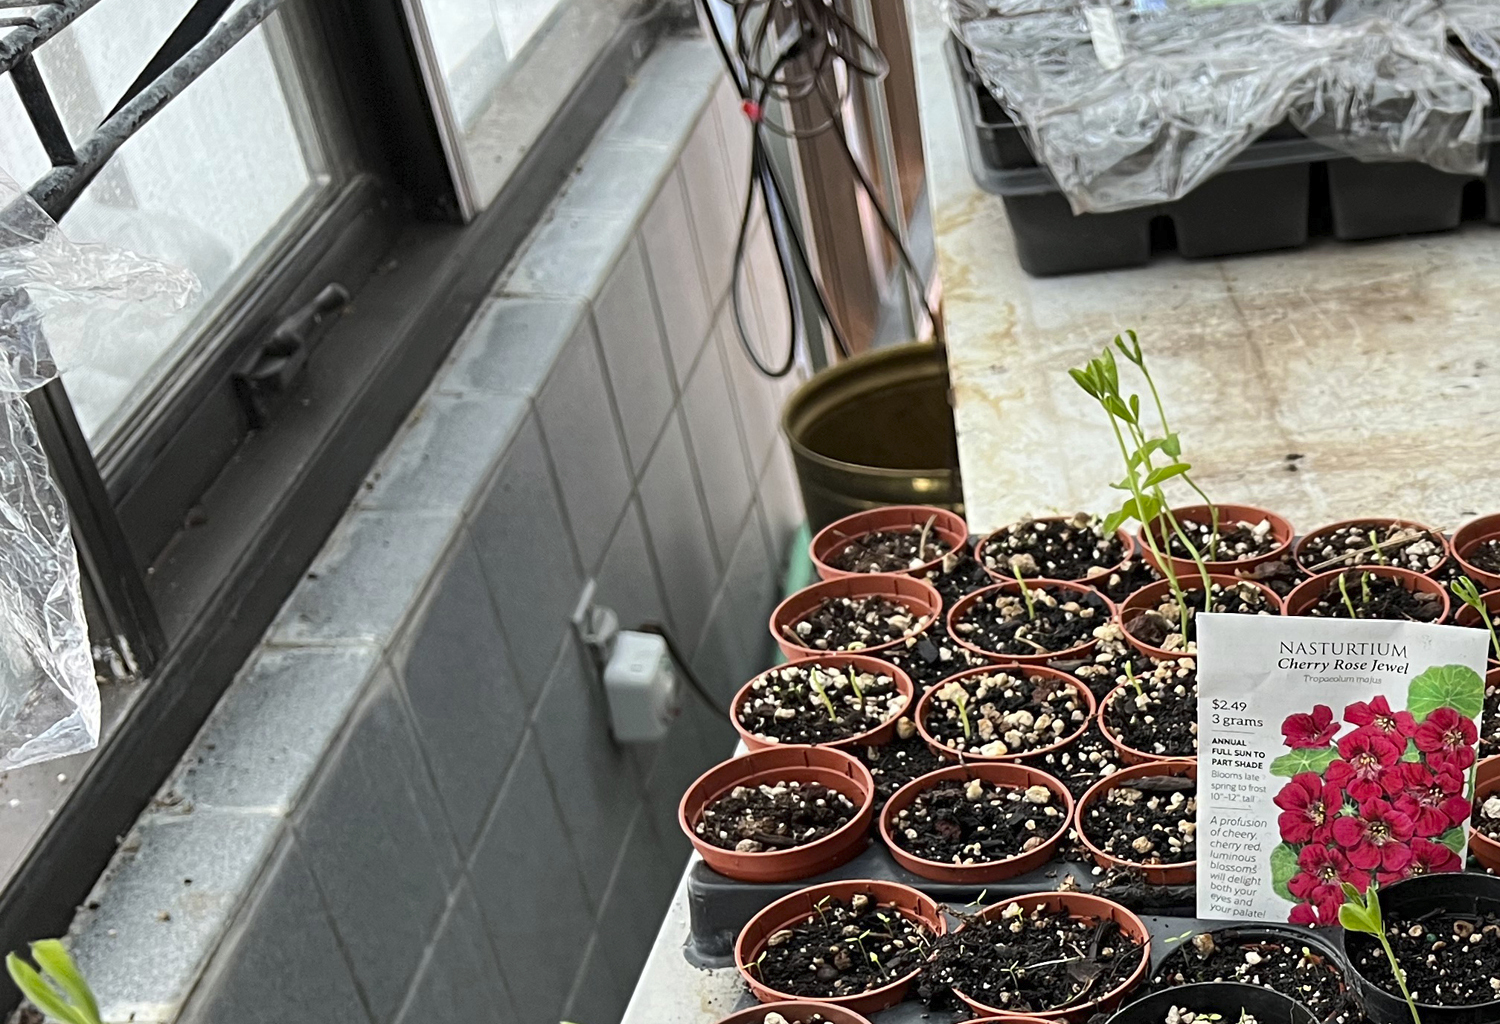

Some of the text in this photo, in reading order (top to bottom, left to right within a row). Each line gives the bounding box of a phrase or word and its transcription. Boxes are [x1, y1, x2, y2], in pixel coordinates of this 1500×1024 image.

[1279, 641, 1408, 659] NASTURTIUM
[1277, 657, 1409, 675] Cherry Rose Jewel
[1303, 674, 1382, 685] Tropaeolum majus
[1212, 699, 1247, 712] $2.49
[1212, 713, 1264, 728] 3 grams
[1211, 737, 1247, 747] ANNUAL
[1211, 747, 1266, 759] FULL SUN TO
[1211, 758, 1263, 770] PART SHADE
[1211, 769, 1260, 782] Blooms late
[1211, 782, 1267, 793] spring to frost
[1210, 816, 1268, 828] A profusion
[1210, 828, 1222, 837] of
[1209, 840, 1262, 852] cherry red,
[1210, 850, 1257, 863] luminous
[1210, 861, 1258, 874] blossoms
[1210, 872, 1262, 886] will delight
[1210, 882, 1258, 897] both your
[1210, 893, 1253, 907] eyes and
[1209, 903, 1267, 919] your palate!
